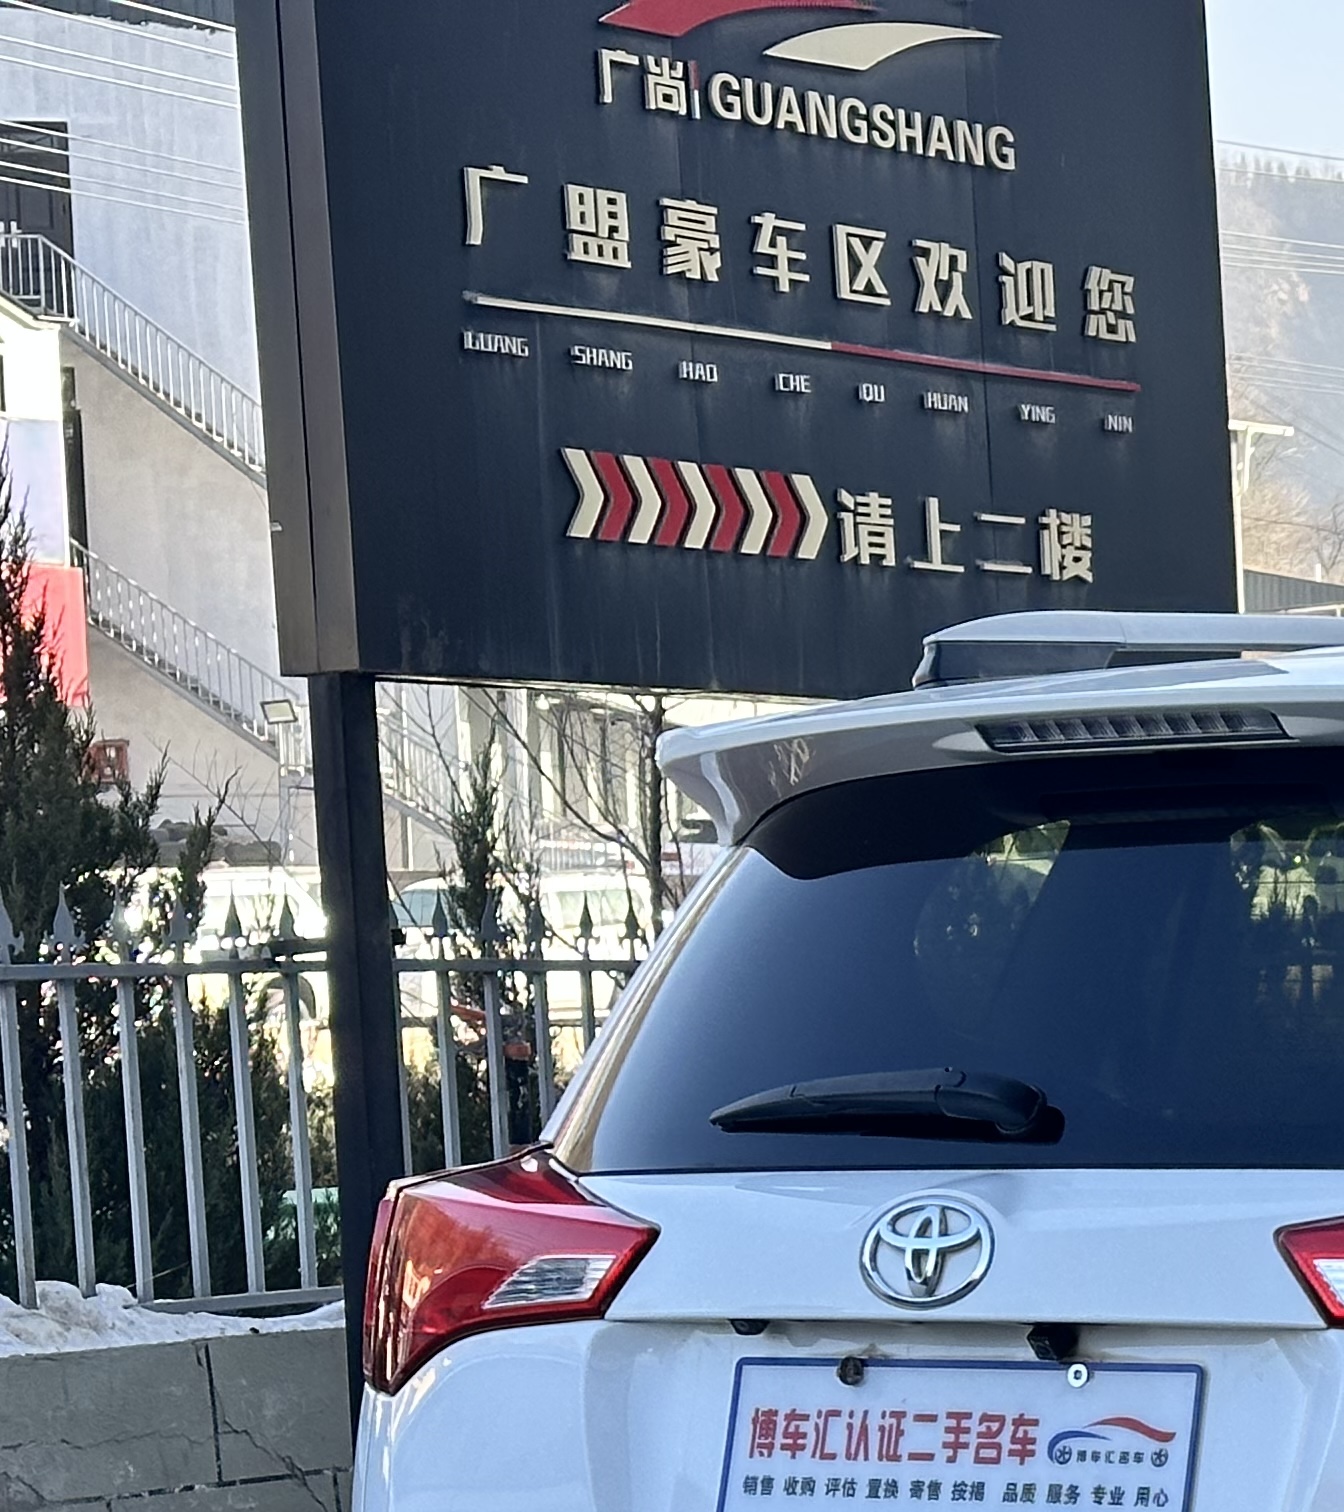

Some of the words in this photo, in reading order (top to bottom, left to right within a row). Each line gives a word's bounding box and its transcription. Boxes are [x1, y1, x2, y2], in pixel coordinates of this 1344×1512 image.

[598, 47, 688, 117] 广尚
[708, 72, 1017, 172] GUANGSHANG
[463, 165, 1137, 343] 广盟豪车区欢迎您
[570, 344, 634, 371] SHANG
[679, 360, 719, 383] HAO
[775, 373, 813, 394] CHE
[923, 391, 969, 414] HUAN
[1019, 403, 1056, 425] YING
[1104, 414, 1133, 433] NIN
[837, 487, 1094, 583] 请上二楼
[748, 1406, 1041, 1466] 博车汇认证二手名车
[742, 1474, 775, 1496] 销售
[783, 1475, 816, 1498] 收购
[824, 1477, 858, 1499] 评估
[865, 1478, 899, 1500] 置换
[1002, 1482, 1038, 1505] 品质
[1046, 1483, 1081, 1506] 服务
[1091, 1484, 1126, 1507] 专业
[1133, 1486, 1170, 1508] 用心
